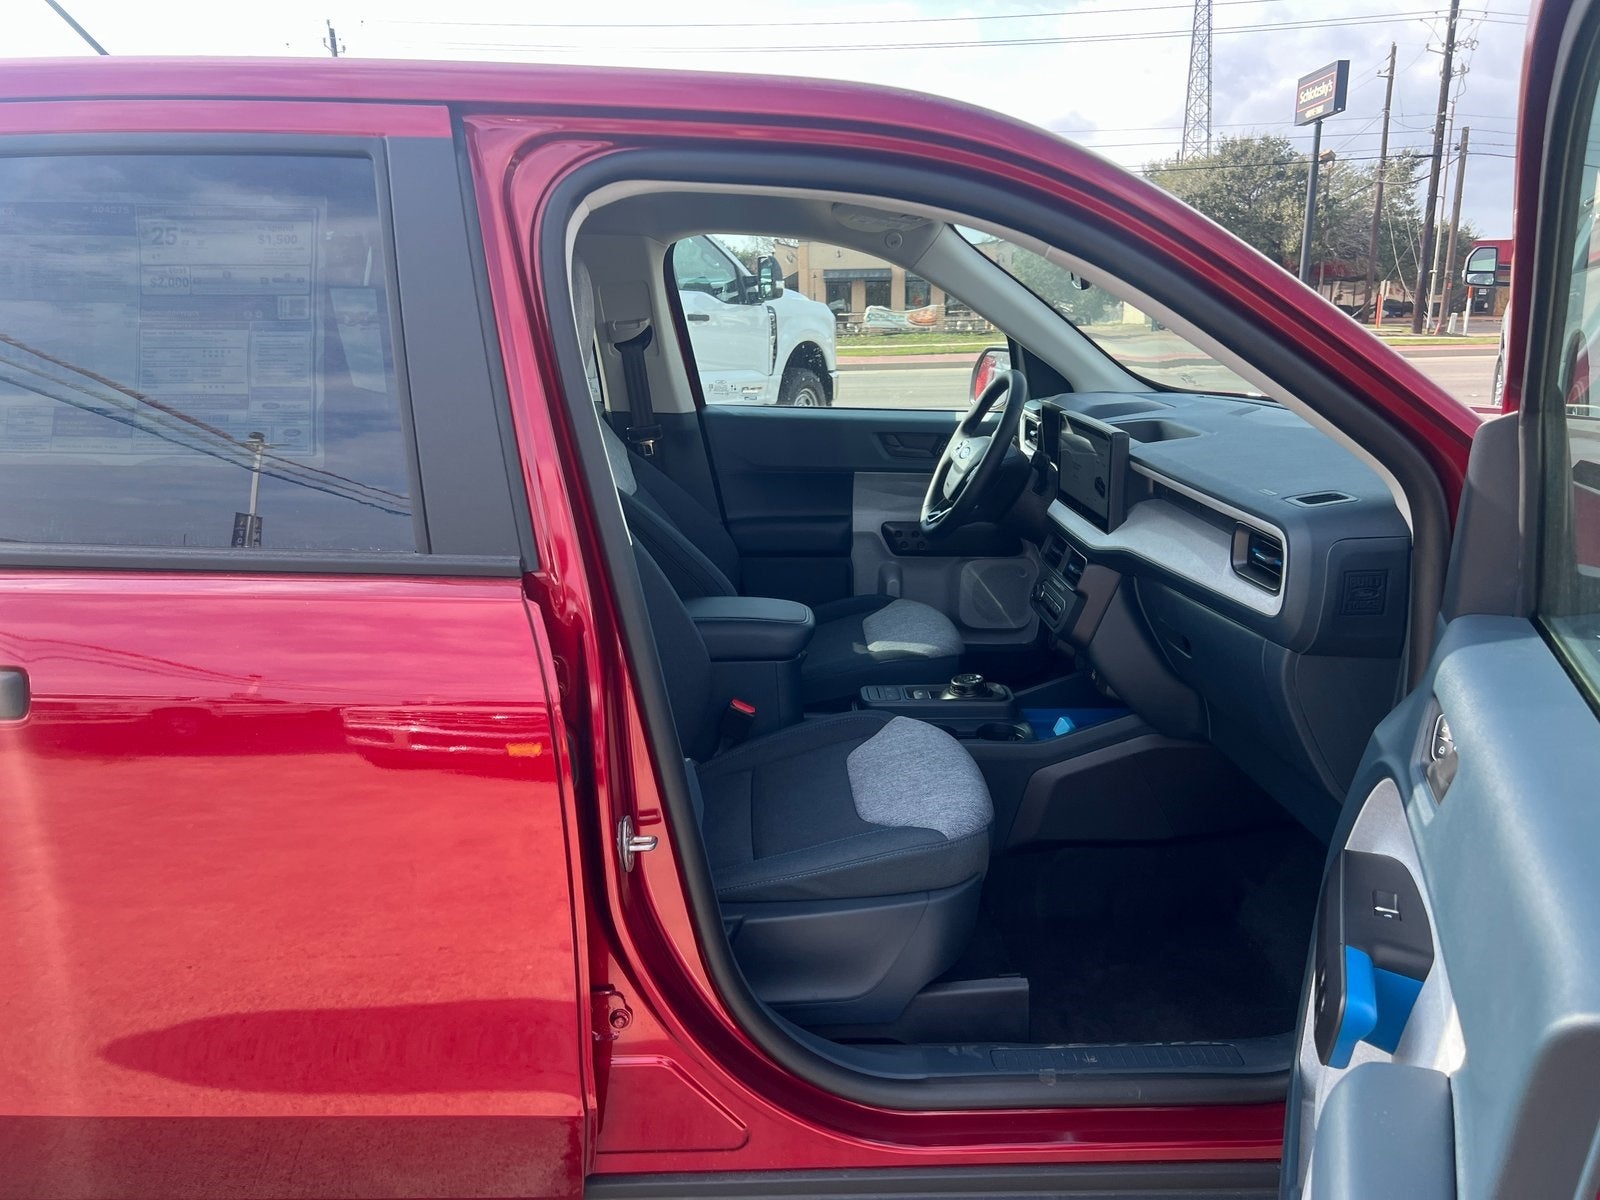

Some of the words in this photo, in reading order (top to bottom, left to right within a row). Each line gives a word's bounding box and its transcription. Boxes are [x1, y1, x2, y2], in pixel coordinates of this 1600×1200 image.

[151, 226, 178, 246] 25
[257, 234, 298, 246] $1,500
[150, 276, 190, 289] $2,000
